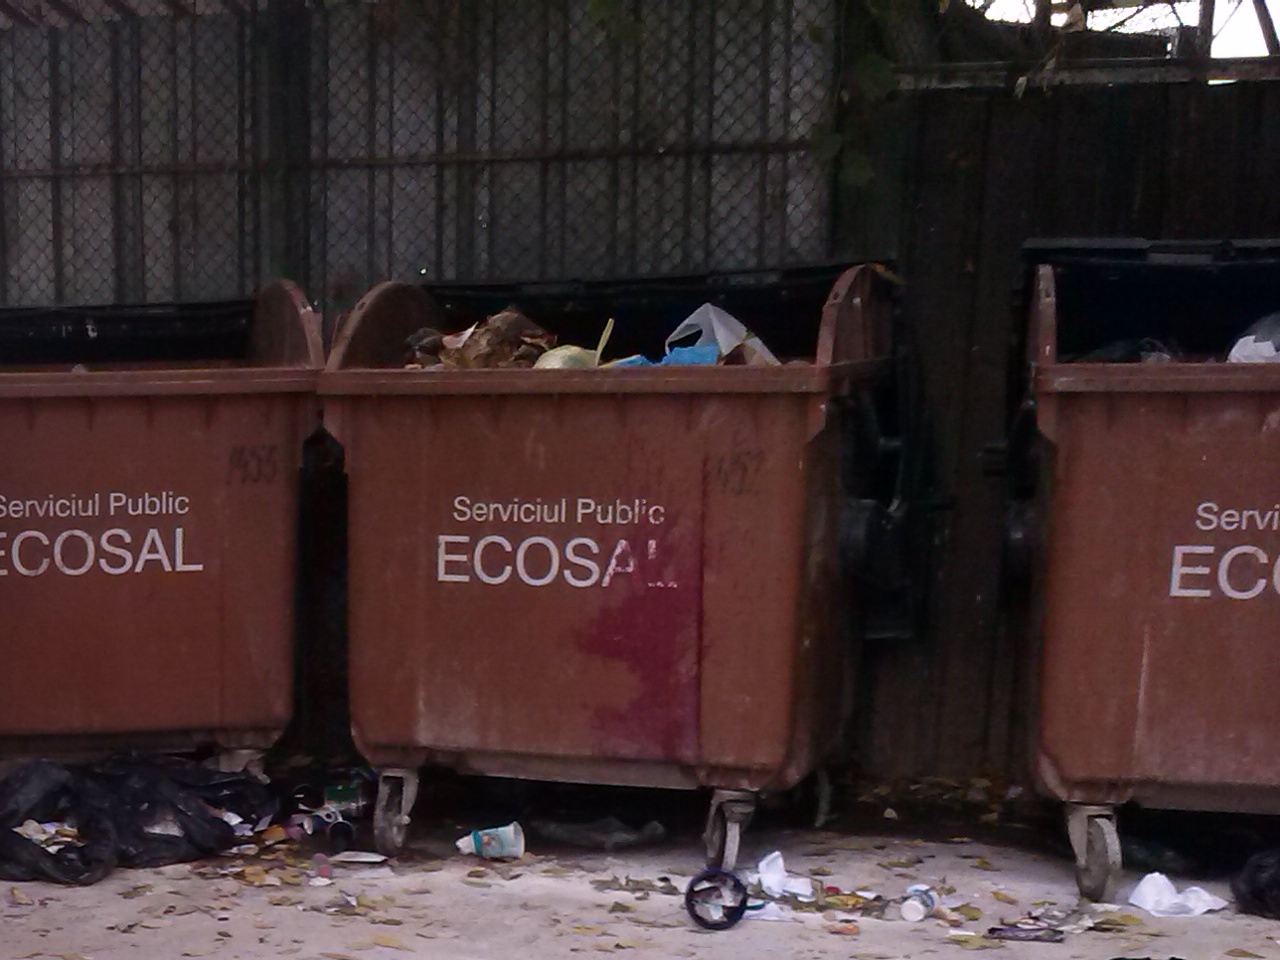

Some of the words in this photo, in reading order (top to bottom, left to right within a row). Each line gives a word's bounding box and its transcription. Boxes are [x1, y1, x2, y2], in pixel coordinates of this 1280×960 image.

[109, 491, 190, 516] Public
[453, 495, 567, 523] Serviciul
[576, 497, 666, 525] Public
[1195, 502, 1280, 531] Servi
[1170, 545, 1280, 600] EC
